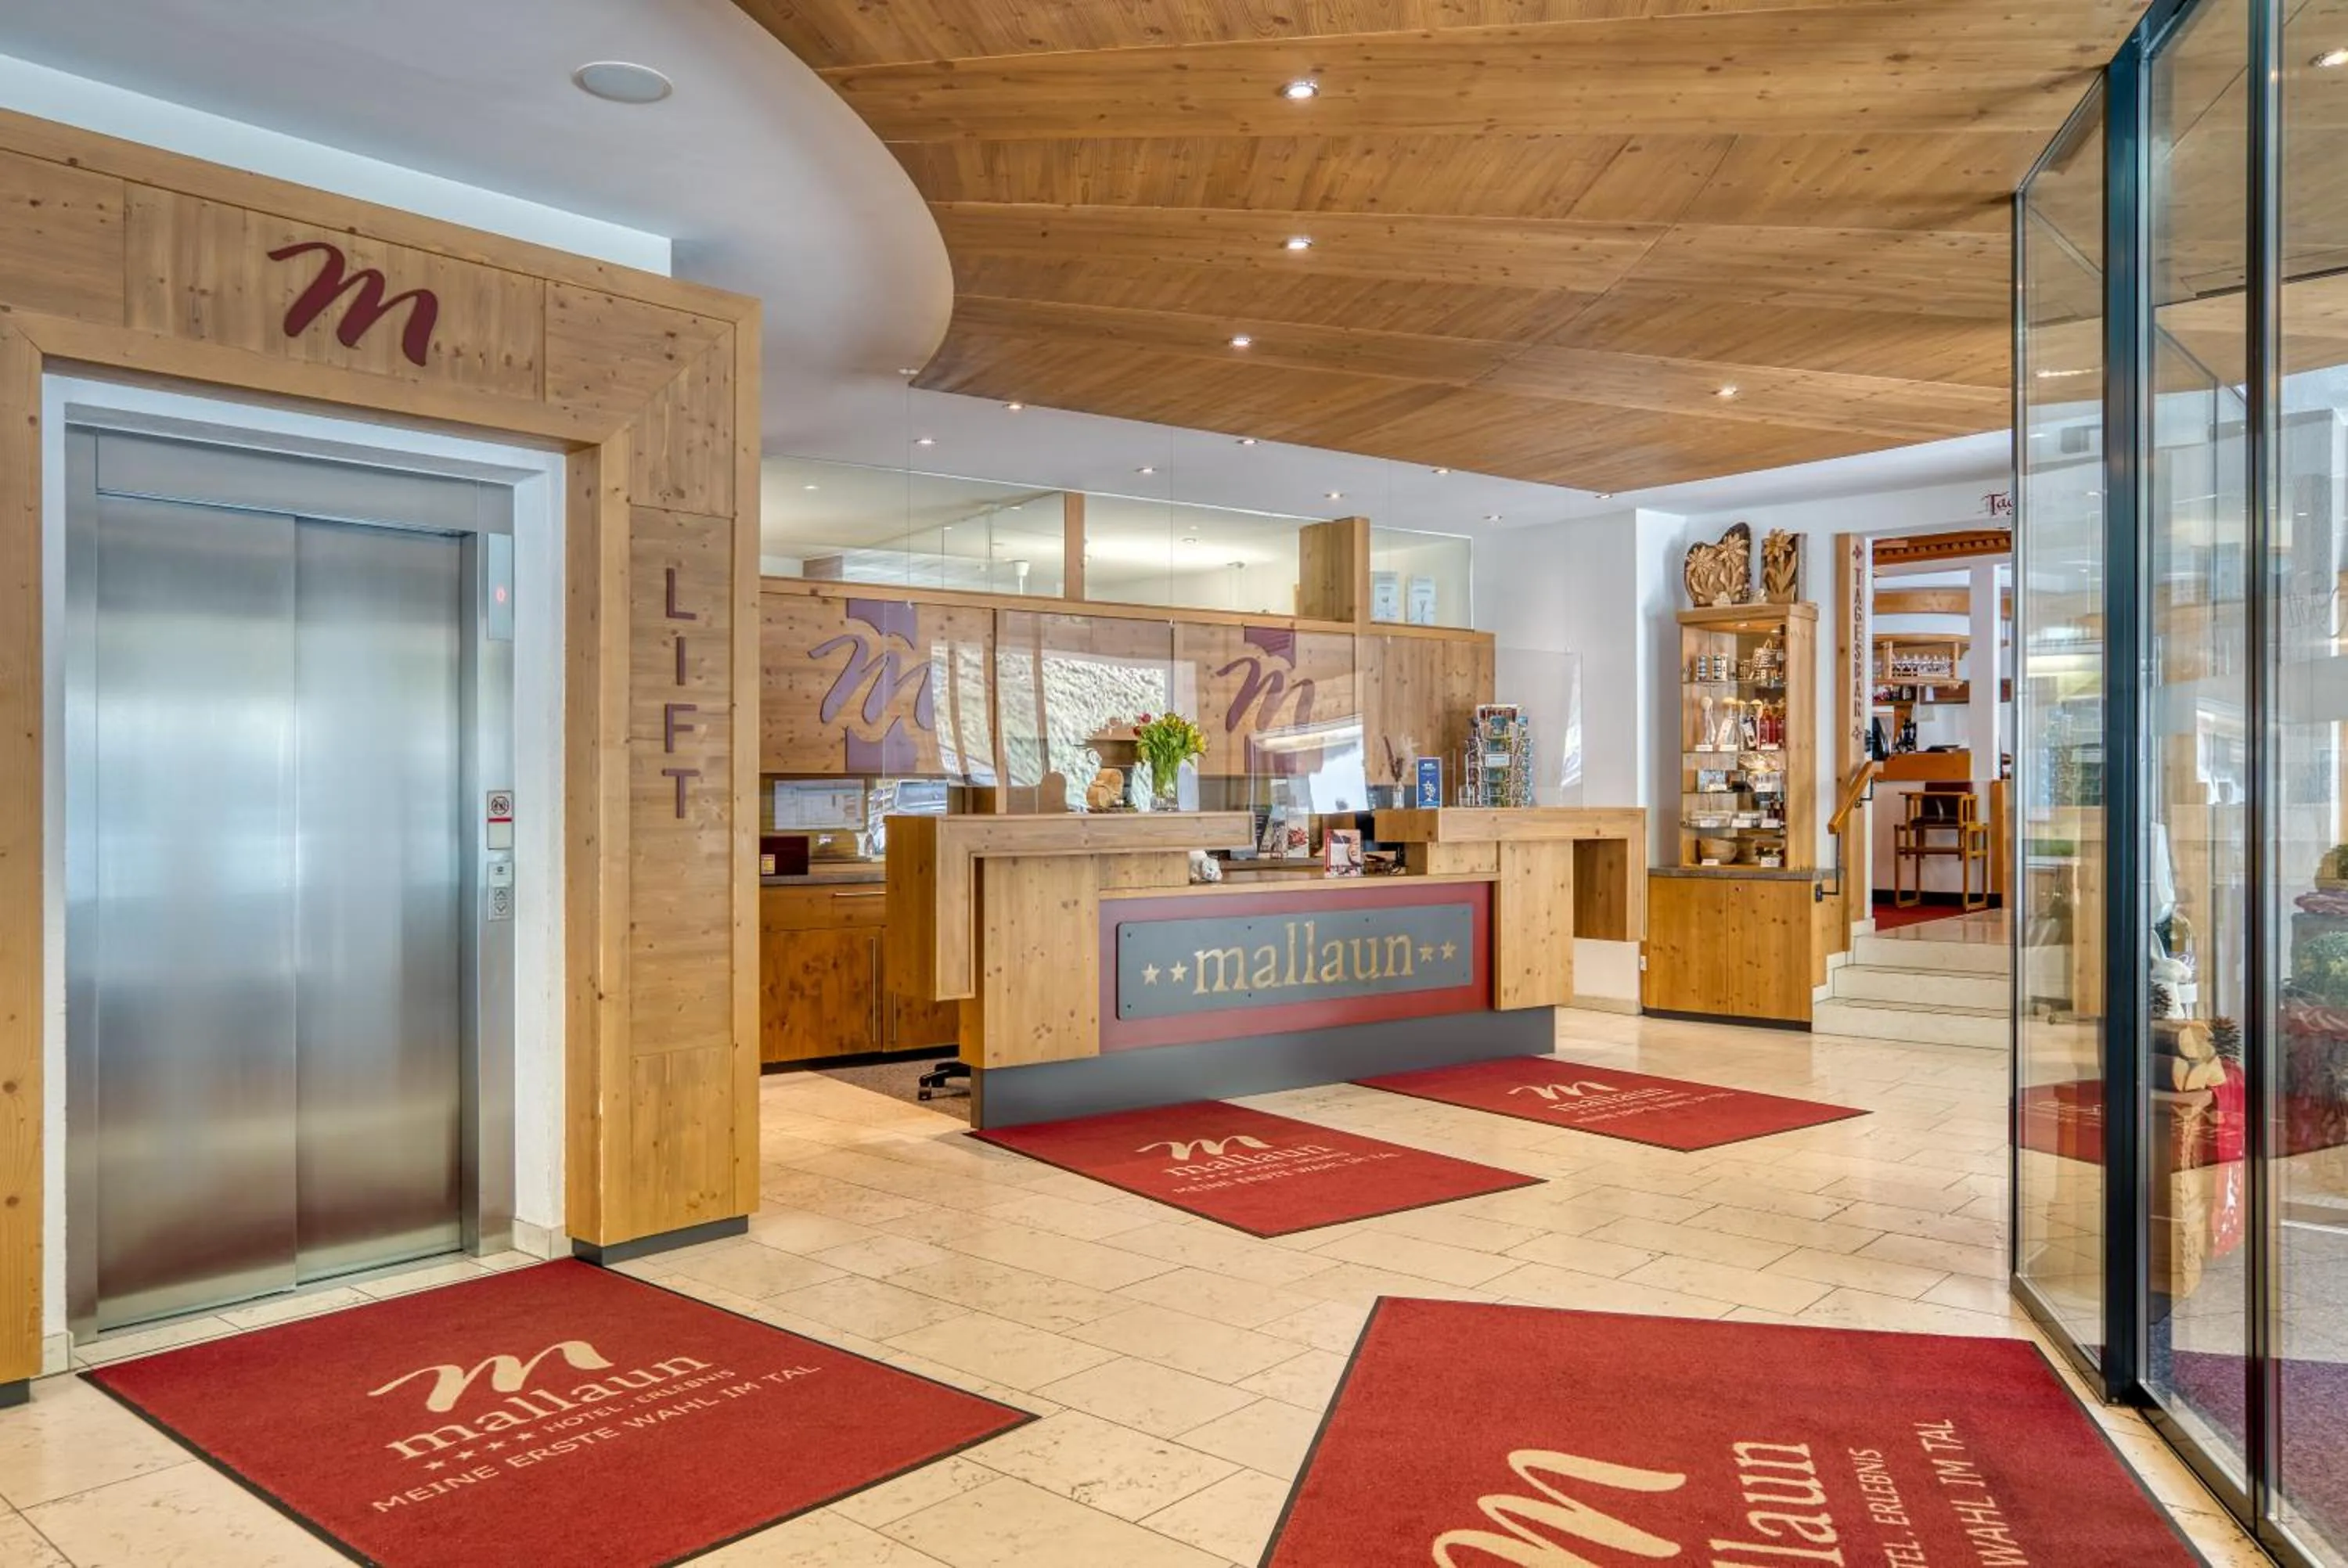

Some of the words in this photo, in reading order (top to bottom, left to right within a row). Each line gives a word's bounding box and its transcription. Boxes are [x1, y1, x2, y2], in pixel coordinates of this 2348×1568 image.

[1853, 567, 1864, 718] TAGESBAR
[662, 567, 700, 819] LIFT
[1191, 919, 1415, 995] mallaun
[372, 1464, 500, 1512] MEINE
[505, 1426, 621, 1468] ERSTE
[622, 1397, 720, 1429] WAHL
[718, 1382, 762, 1398] IM
[761, 1366, 821, 1383] TAL
[385, 1357, 713, 1461] mallaun
[542, 1406, 625, 1433] HOTEL
[633, 1369, 736, 1404] ERLEBNIS
[1913, 1419, 1964, 1452] TAL
[1848, 1448, 1910, 1526] ERLEBNIS
[1932, 1458, 1986, 1487] IM
[1950, 1495, 2029, 1566] WAHL
